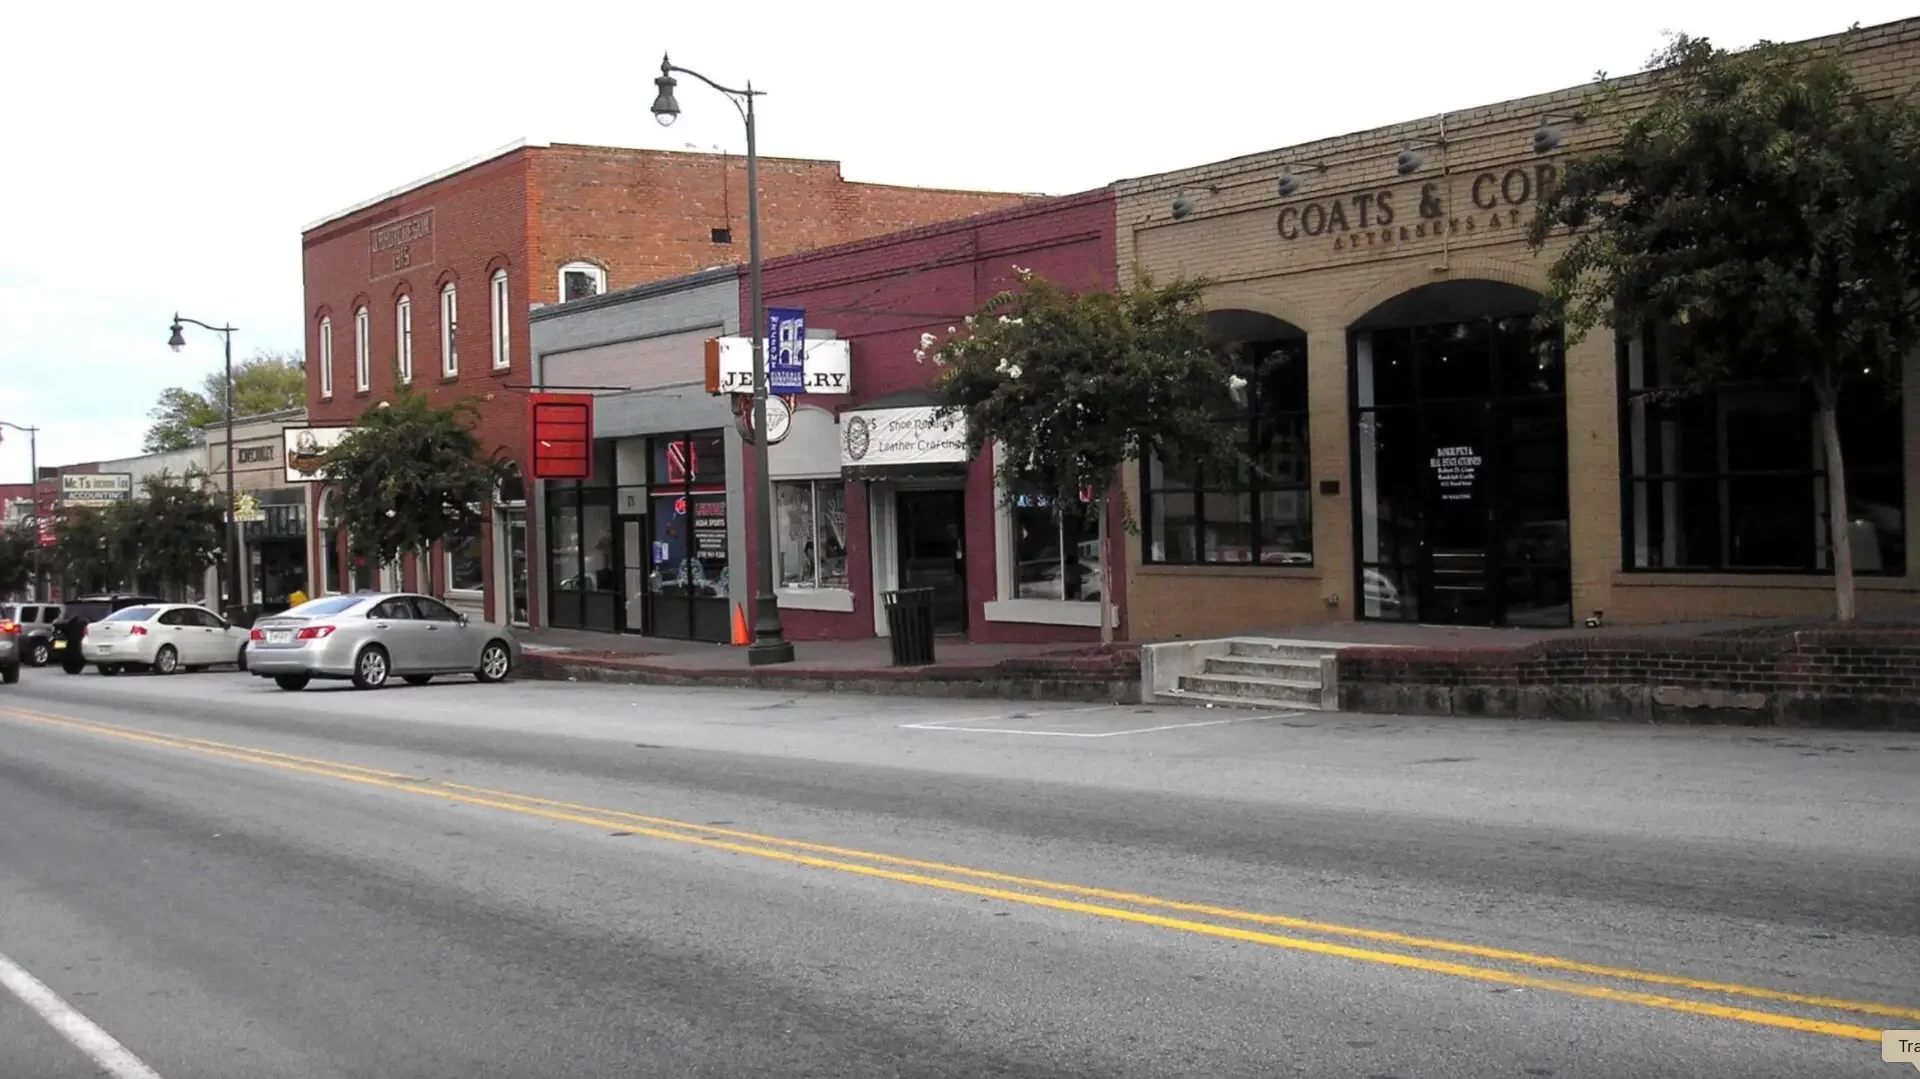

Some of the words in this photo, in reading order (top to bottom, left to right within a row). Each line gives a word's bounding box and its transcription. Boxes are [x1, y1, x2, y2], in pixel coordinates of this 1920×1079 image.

[1277, 190, 1394, 240] COATS
[1419, 182, 1444, 219] &
[1471, 162, 1560, 210] COP
[724, 371, 846, 387] JERY
[889, 420, 912, 432] Shoe
[879, 440, 914, 453] Leather
